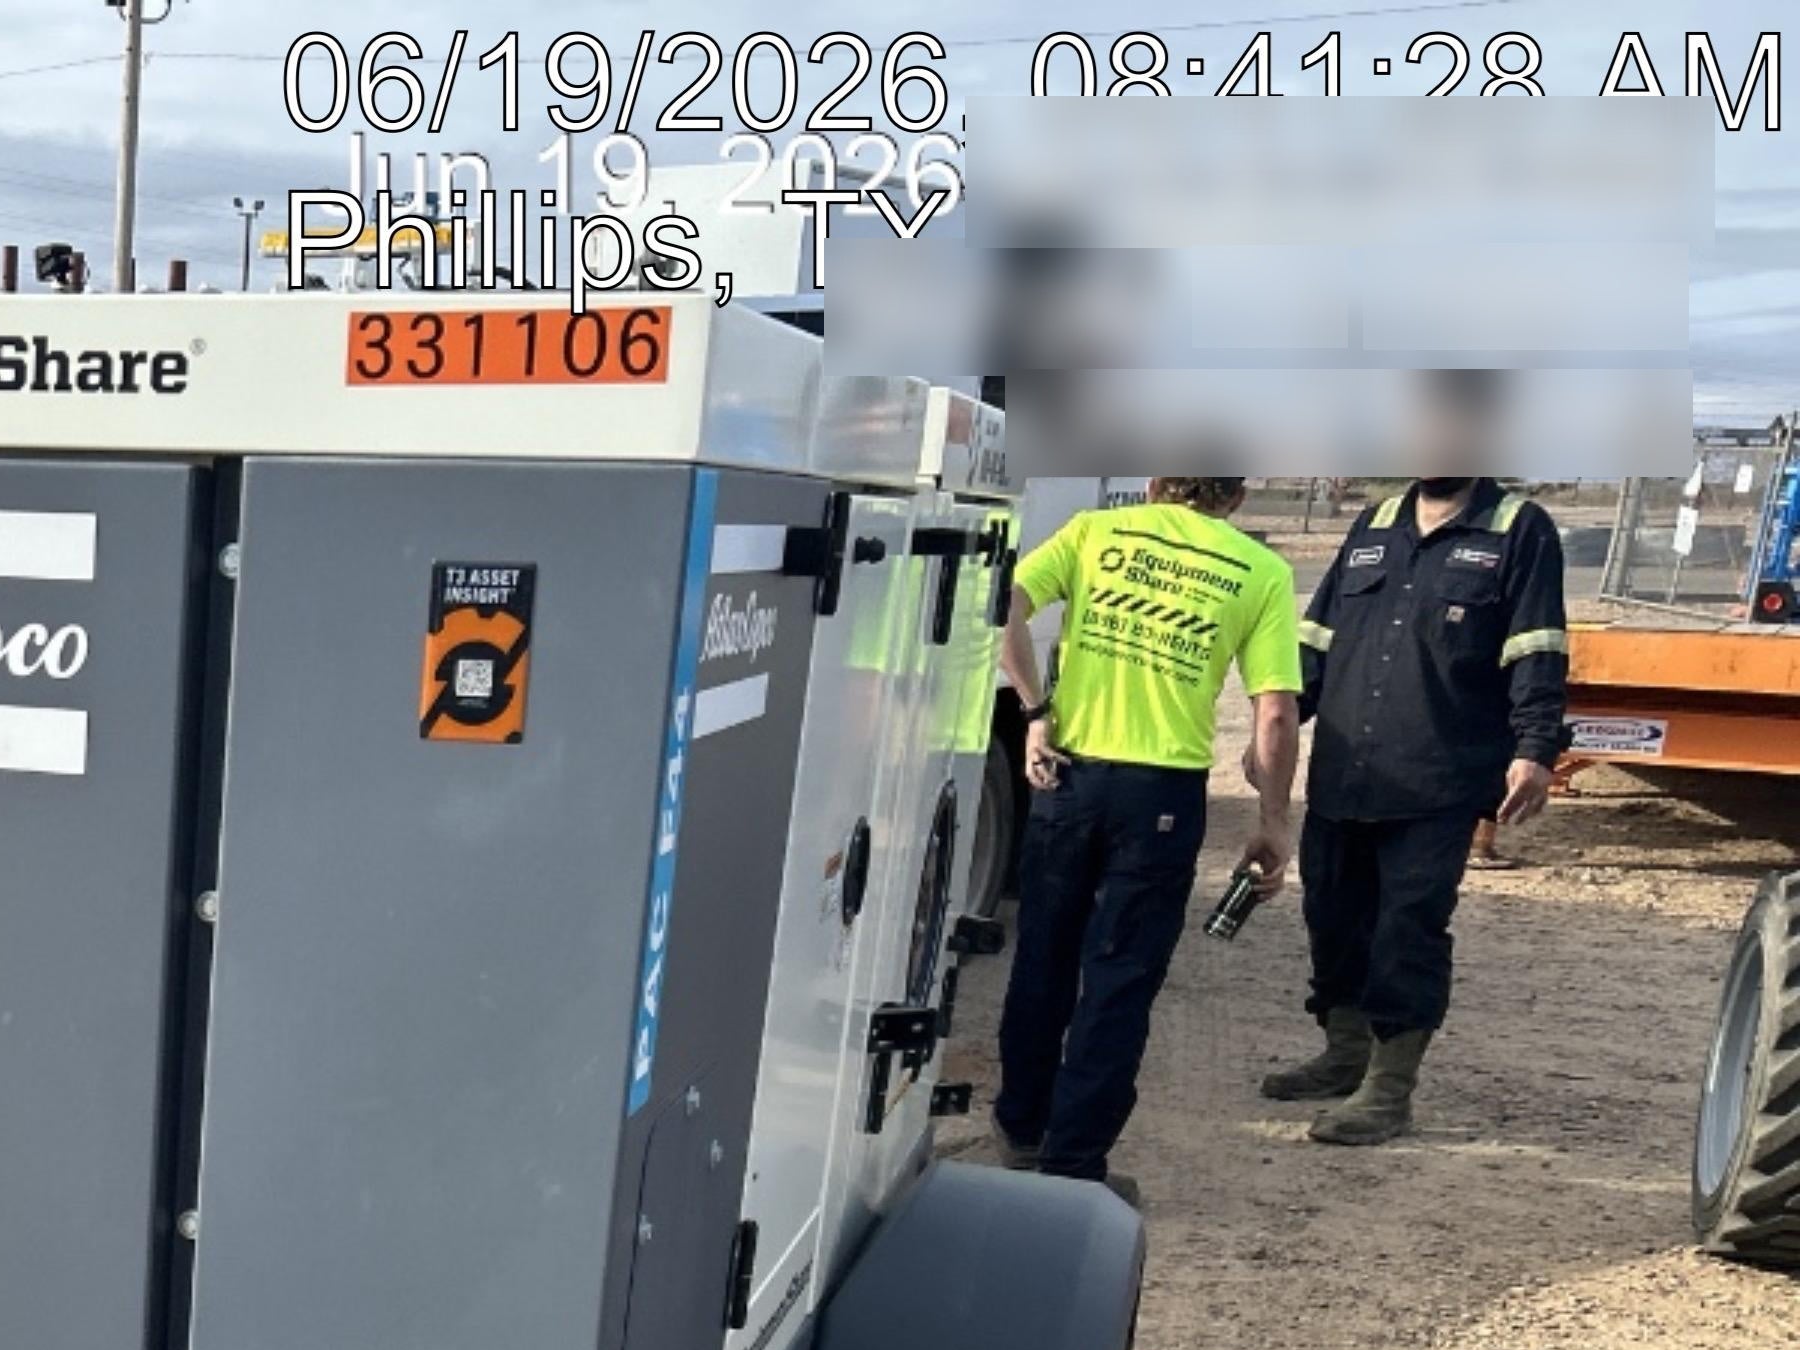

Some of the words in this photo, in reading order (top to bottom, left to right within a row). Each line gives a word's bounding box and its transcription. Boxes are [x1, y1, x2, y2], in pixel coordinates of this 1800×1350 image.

[356, 308, 661, 381] 331106
[470, 568, 520, 587] ASSET
[1124, 566, 1183, 595] Share
[1130, 548, 1243, 598] Equipment
[444, 586, 511, 604] INSIGHT
[634, 890, 667, 1081] PAC
